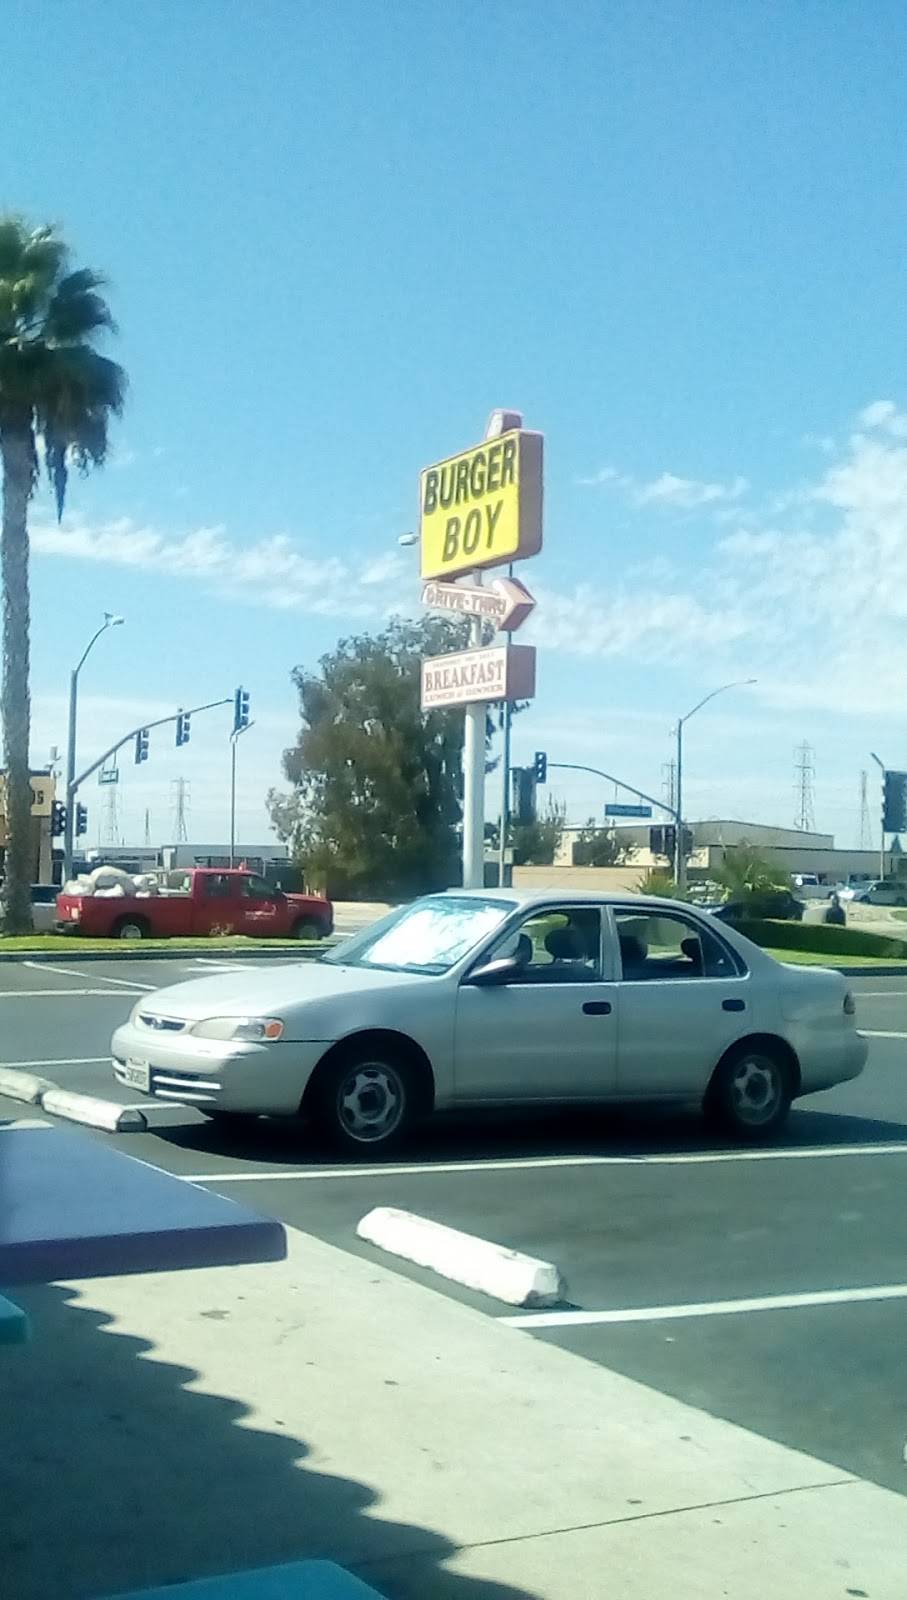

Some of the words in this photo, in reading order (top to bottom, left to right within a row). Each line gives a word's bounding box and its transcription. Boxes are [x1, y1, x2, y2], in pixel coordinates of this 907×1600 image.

[424, 439, 516, 515] BURGER
[442, 500, 503, 561] BOY
[425, 659, 504, 692] BREAKFAST
